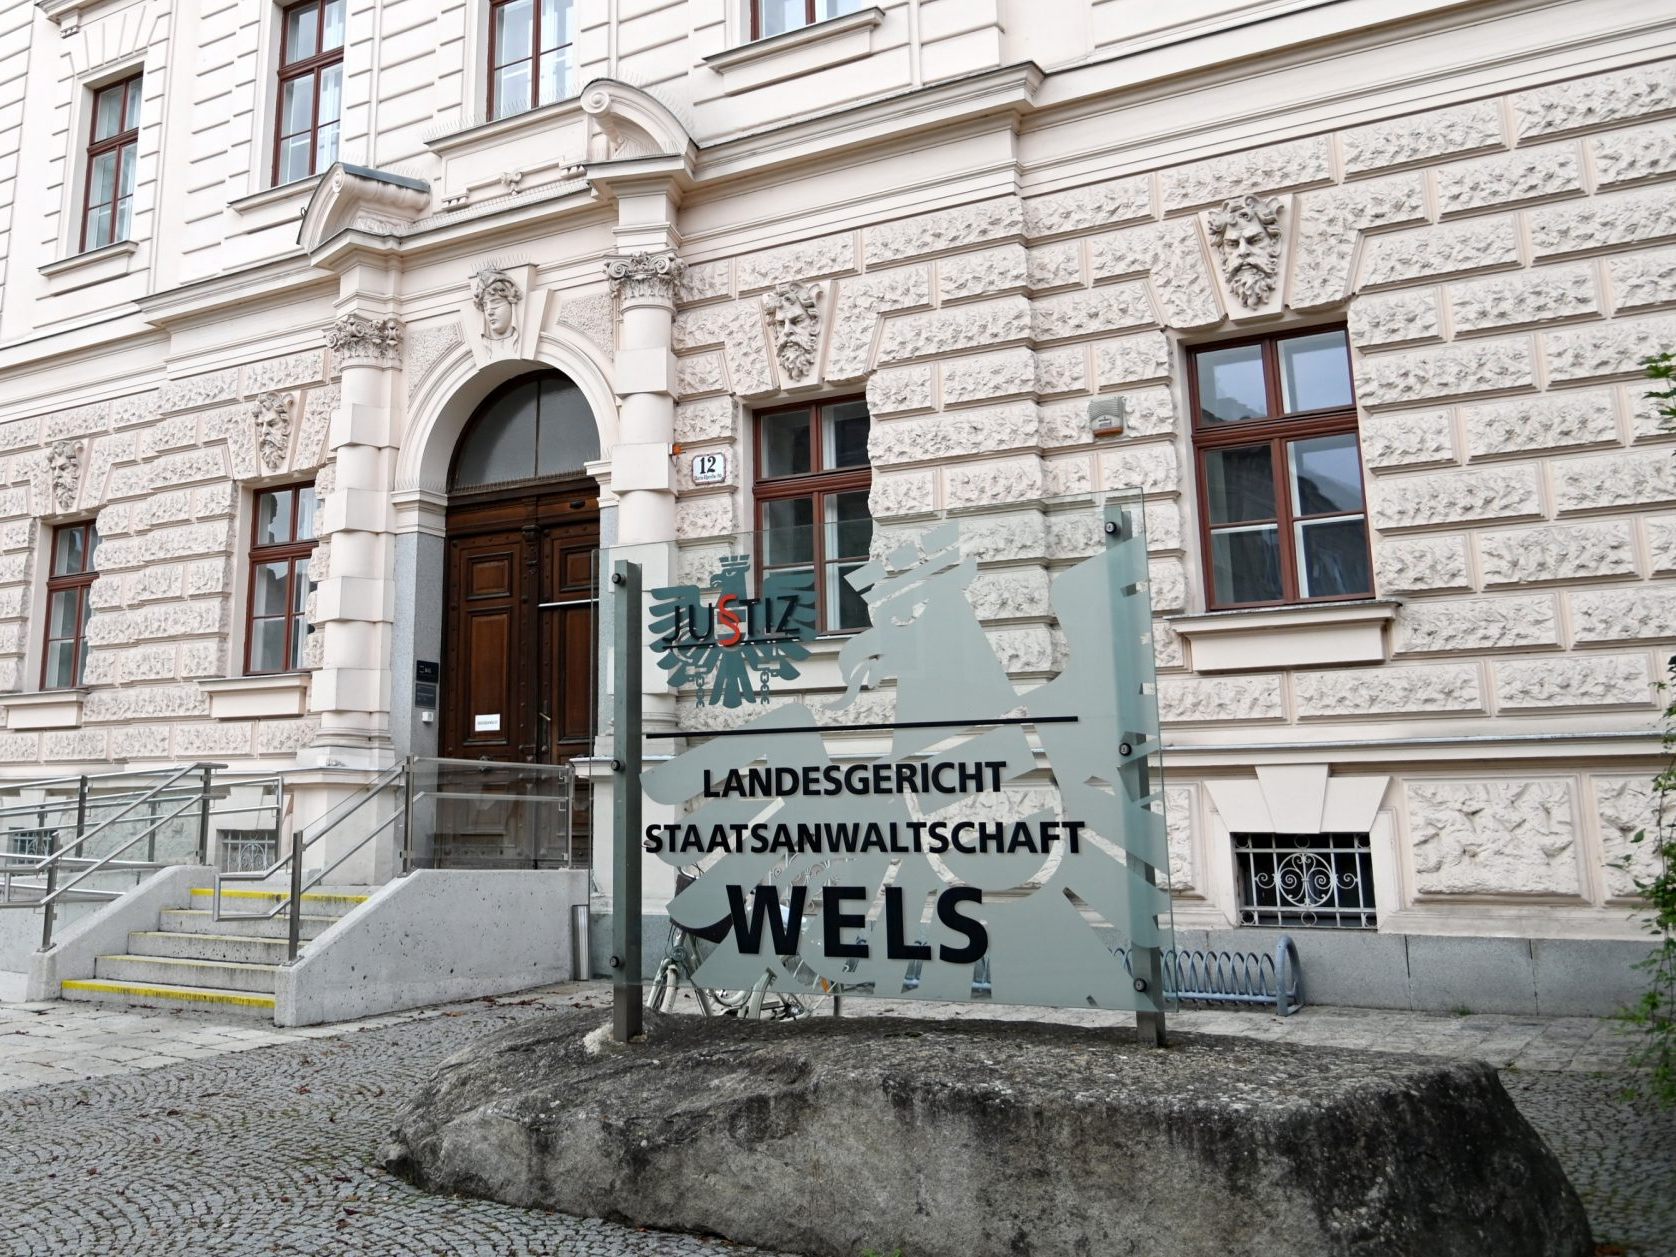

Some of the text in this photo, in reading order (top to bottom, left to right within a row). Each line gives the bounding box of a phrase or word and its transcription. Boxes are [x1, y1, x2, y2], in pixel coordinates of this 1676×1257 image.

[700, 456, 716, 474] 12
[703, 760, 1007, 798] LANDESGERICHT
[645, 820, 1085, 854] STAATSANWALTSCHAFT
[726, 884, 989, 964] WELS
